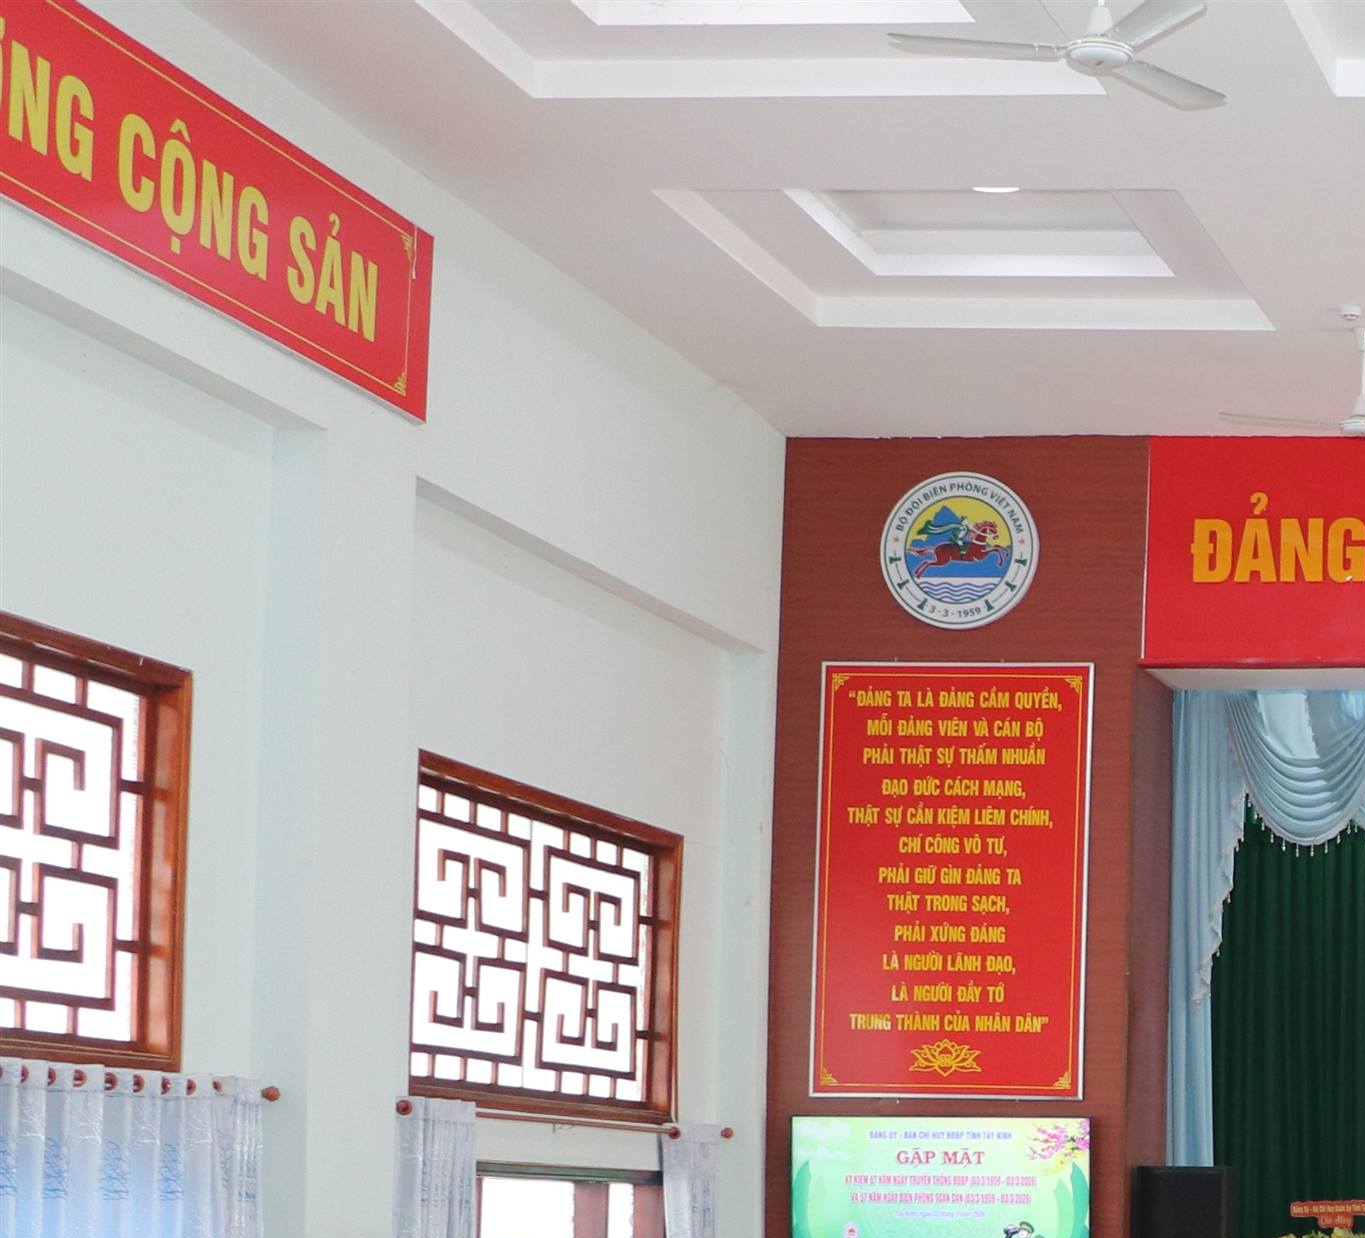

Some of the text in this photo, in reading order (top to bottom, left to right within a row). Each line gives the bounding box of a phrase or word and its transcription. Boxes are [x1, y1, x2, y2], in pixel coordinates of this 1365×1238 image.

[0, 16, 379, 343] NG CỘNG SẢN
[1191, 493, 1365, 582] ĐẢNG
[897, 691, 912, 706] TA
[917, 688, 934, 707] LÀ
[939, 687, 974, 708] ĐẢNG
[980, 686, 1009, 708] CẦM
[1015, 687, 1062, 711] QUYỀN,
[867, 713, 1043, 741] MỖI ĐẢNG VIÊN VÀ CÁN BỘ
[864, 743, 1045, 768] PHẢI THẬT SỰ THẤM NHUẦN
[882, 776, 1025, 799] ĐẠO ĐỨC CÁCH MẠNG,
[848, 802, 1052, 828] THẬT SỰ CẦN KIỆM LIÊM CHÍNH,
[899, 834, 1007, 856] CHÍ CÔNG VÔ TƯ,
[879, 863, 1021, 885] PHẢI GIỮ GÌN ĐẢNG TA
[887, 892, 1009, 914] THẬT TRONG SẠCH,
[894, 921, 1005, 943] PHẢI XỨNG ĐÁNG
[883, 950, 1015, 975] LÀ NGƯỜI LÃNH ĐẠO,
[892, 980, 1004, 1002] LÀ NGƯỜI ĐẦY TỚ
[849, 1014, 891, 1030] TRUNG
[896, 1011, 940, 1031] THÀNH
[944, 1010, 970, 1031] CỦA
[976, 1012, 1010, 1032] NHÂN
[896, 1148, 986, 1168] GẶP MẶT
